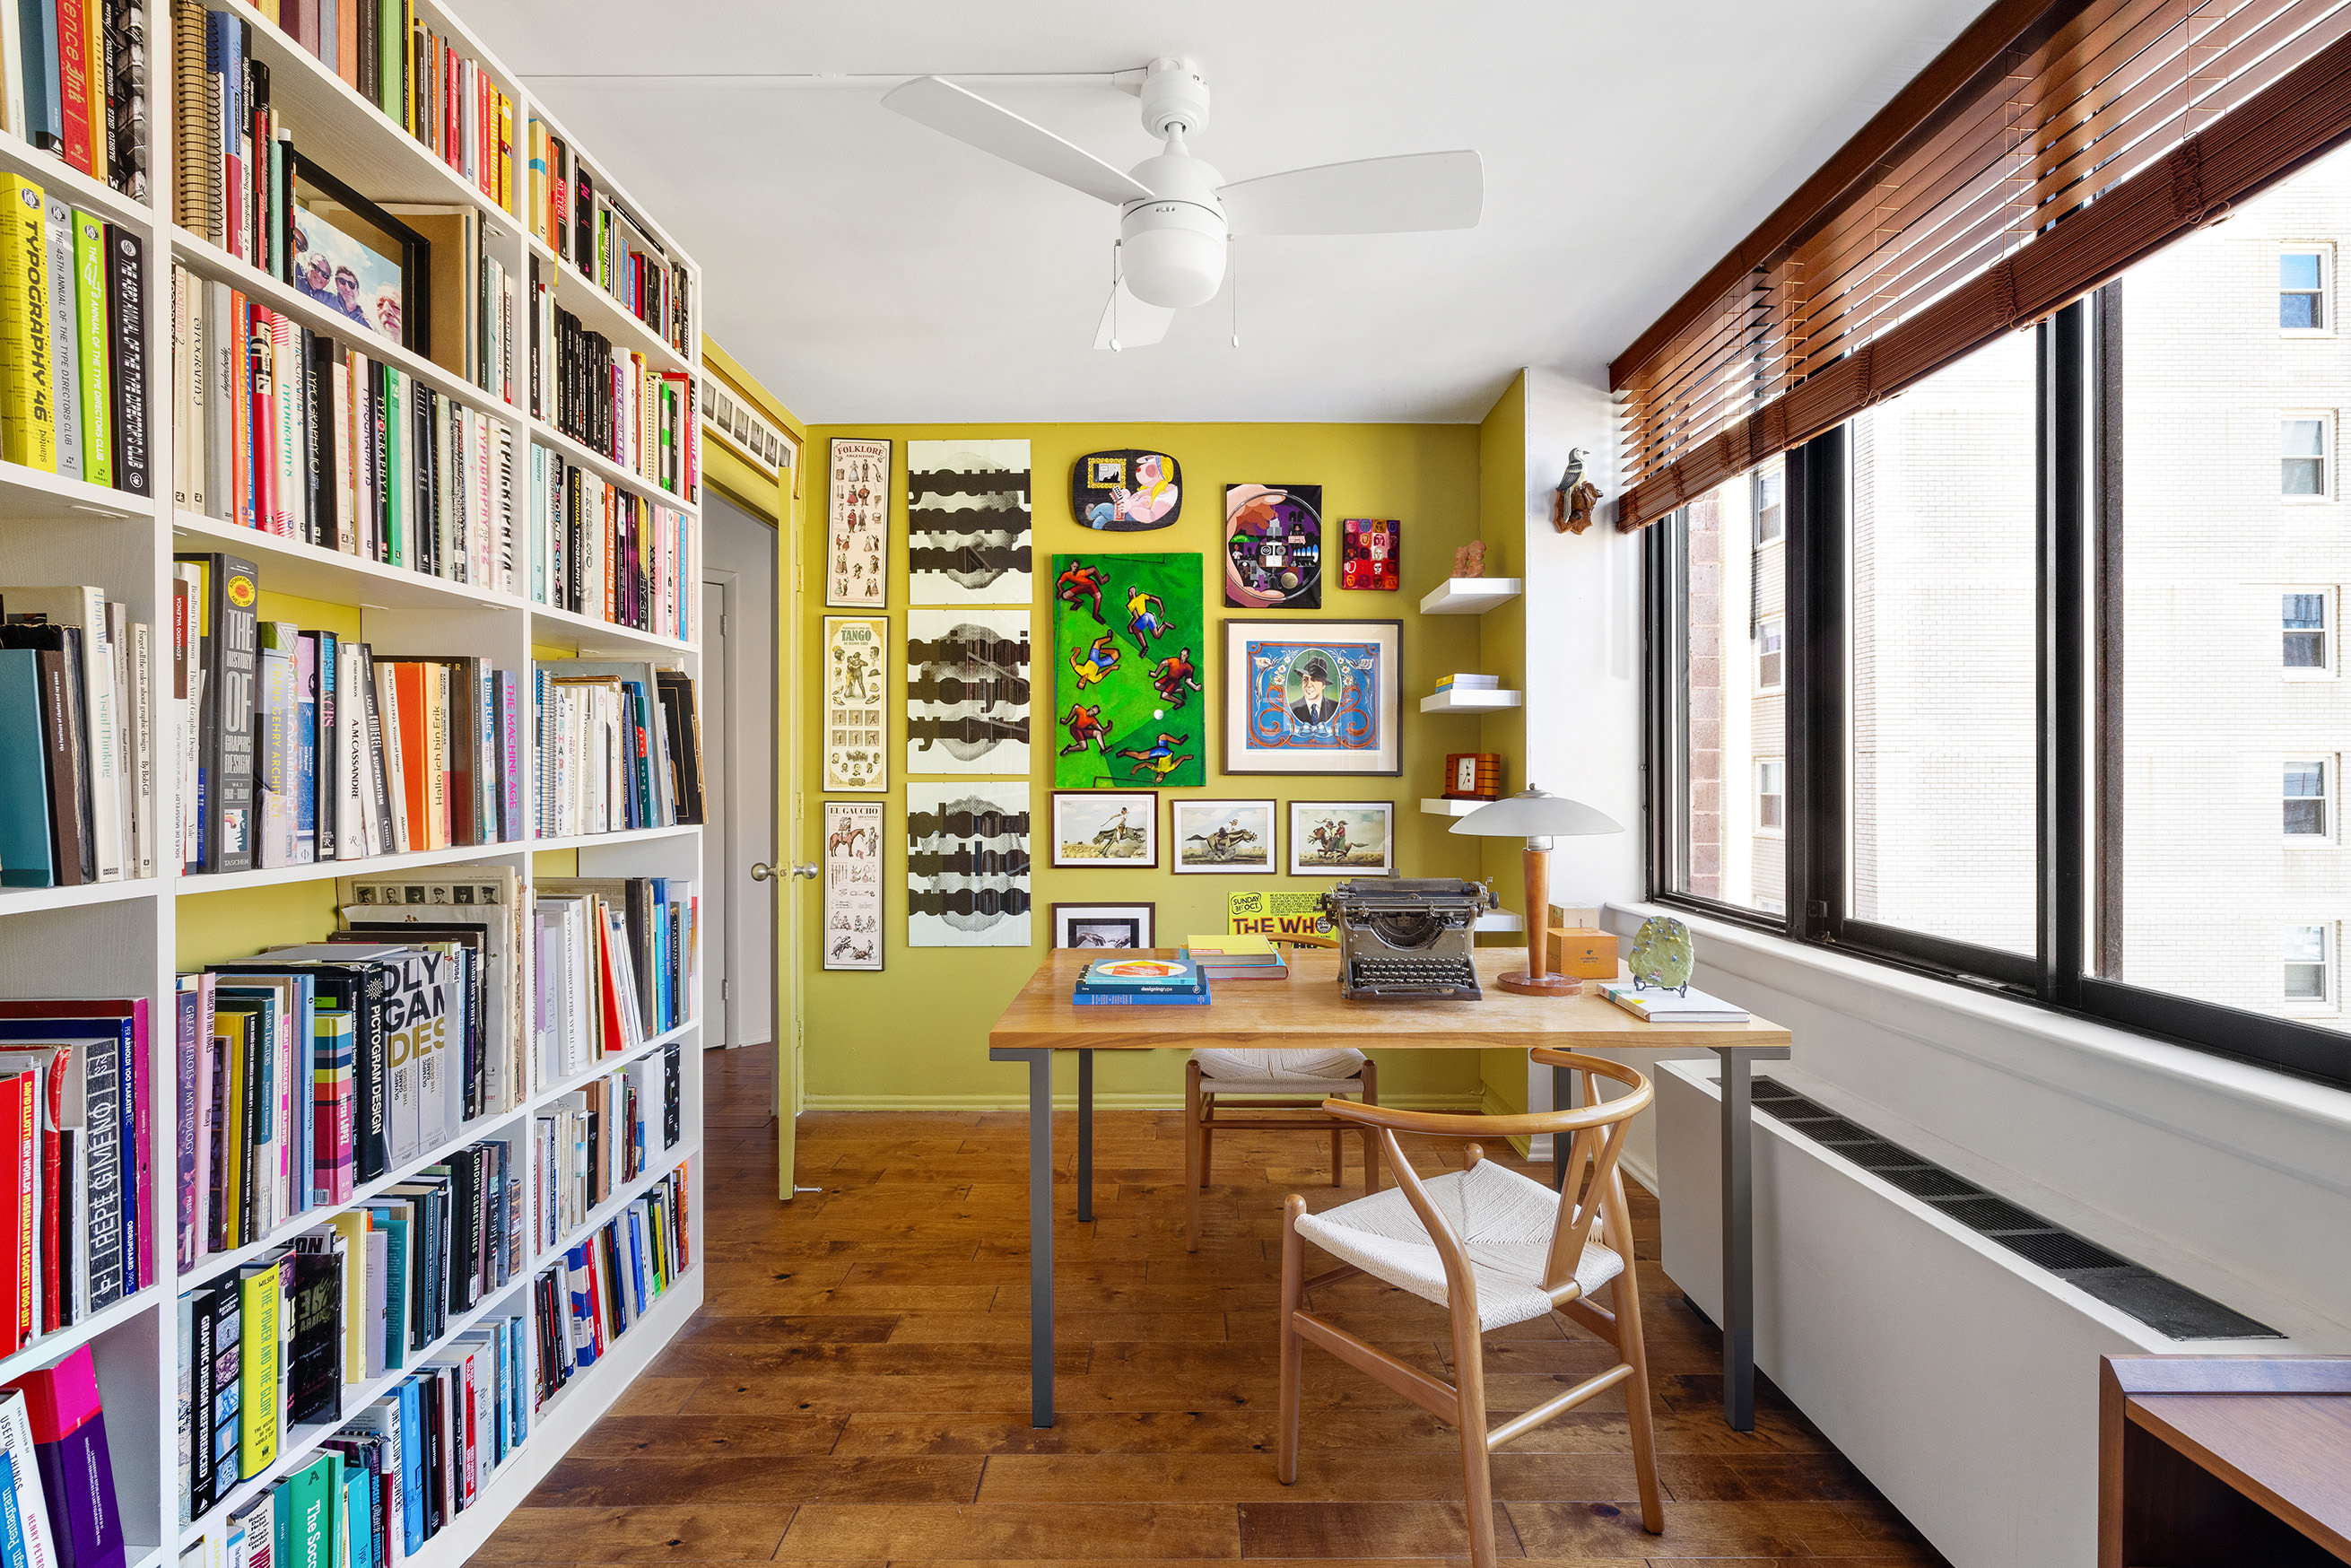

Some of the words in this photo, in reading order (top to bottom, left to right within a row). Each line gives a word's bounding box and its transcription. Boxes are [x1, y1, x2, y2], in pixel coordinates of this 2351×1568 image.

[242, 91, 250, 133] Pensamiento
[242, 163, 250, 189] Thought
[557, 179, 565, 191] MY
[242, 191, 250, 232] Typographic
[557, 191, 565, 215] TYPE
[55, 229, 64, 246] THE
[56, 248, 65, 273] 45TH
[121, 258, 137, 278] THE
[57, 273, 66, 307] ANNUAL
[122, 278, 138, 302] 43RD
[24, 221, 47, 387] TYPOGRAPHY
[58, 309, 67, 324] OF
[123, 299, 139, 335] ANNUAL
[175, 272, 187, 338] Typography
[59, 326, 68, 344] THE
[124, 336, 140, 351] OF
[176, 337, 186, 346] 2
[60, 345, 69, 367] TYPE
[125, 350, 141, 370] THE
[194, 317, 203, 397] TYPOGRAPHY
[221, 347, 231, 392] Typography
[61, 368, 71, 421] DIRECTORS
[125, 370, 141, 393] TYPE
[282, 383, 292, 466] TYPOGRAPHY
[308, 370, 319, 454] TYPOGRAPHY
[38, 428, 48, 463] slanted
[63, 422, 72, 446] CLUB
[377, 396, 387, 488] TYPOGRAPHY
[127, 444, 144, 469] CLUB
[838, 445, 884, 457] FOLKLORE
[284, 467, 293, 478] 8
[309, 457, 320, 474] 10
[478, 424, 489, 529] TYPOGRAPHY
[379, 489, 387, 504] 14
[91, 593, 105, 629] Henry
[188, 584, 198, 619] Bradbury
[137, 630, 147, 650] Forget
[188, 621, 197, 660] Thompson
[228, 610, 255, 652] THE
[841, 630, 872, 641] TANGO
[139, 650, 147, 659] all
[139, 659, 147, 669] the
[227, 650, 253, 670] HISTORY
[139, 669, 147, 686] rules
[188, 670, 196, 684] The
[188, 684, 196, 697] Art
[271, 664, 282, 702] FRANK
[188, 697, 196, 706] of
[225, 670, 252, 732] OF
[366, 694, 374, 714] LAZAR
[484, 681, 493, 704] Blue
[506, 683, 516, 710] THE
[100, 693, 111, 725] Visual
[138, 705, 148, 730] graphic
[187, 706, 196, 735] Graphic
[323, 701, 335, 727] CBS
[432, 706, 440, 727] Erik
[485, 705, 494, 735] Rider
[271, 706, 282, 747] GEHRY
[369, 714, 382, 750] KHIDEKEL
[100, 727, 113, 779] Thinking
[139, 730, 148, 754] design.
[187, 736, 196, 762] Design
[224, 735, 251, 753] GRAPHIC
[433, 731, 441, 750] bin
[507, 713, 517, 777] MACHINE
[139, 761, 148, 771] By
[224, 753, 250, 774] DESIGN
[351, 719, 359, 799] A.M.CASSANDRE
[434, 752, 442, 771] ich
[141, 771, 149, 784] Bob
[141, 784, 149, 798] Gill.
[271, 751, 282, 819] ARCHITECT
[374, 755, 384, 806] SUPREMATISM
[434, 774, 443, 806] Hallo
[508, 781, 518, 809] AGE
[224, 858, 250, 867] TASCHEN
[1232, 895, 1259, 905] SUNDAY
[1232, 917, 1275, 935] THE
[206, 989, 215, 1008] MARCH
[185, 1005, 196, 1037] GREAT
[205, 1020, 214, 1033] THE
[265, 1009, 273, 1029] FARM
[125, 1036, 133, 1066] ARNOLDI
[205, 1033, 214, 1054] FINALS
[264, 1031, 273, 1066] TRACTORS
[370, 1005, 380, 1085] PICTOGRAM
[185, 1040, 195, 1079] HEROES
[23, 1081, 32, 1104] DAVID
[185, 1081, 194, 1089] of
[185, 1091, 195, 1155] MYTHOLOGY
[371, 1086, 381, 1135] DESIGN
[281, 1110, 289, 1146] MAJEWSKI
[22, 1139, 32, 1157] NEW
[89, 1102, 115, 1190] GIMENO
[22, 1157, 32, 1194] WORLDS
[22, 1194, 31, 1226] RUSSIAN
[472, 1194, 480, 1254] CEMETERIES
[126, 1220, 135, 1270] ORDRUPGAARD
[127, 1271, 135, 1286] 1995
[258, 1275, 274, 1288] WILSON
[20, 1286, 30, 1328] 1900-1937
[261, 1285, 273, 1307] THE
[200, 1314, 210, 1364] GRAPHIC
[261, 1308, 273, 1343] POWER
[261, 1344, 273, 1365] AND
[200, 1365, 209, 1406] DESIGN
[260, 1367, 272, 1386] THE
[259, 1388, 272, 1419] GLORY
[391, 1409, 400, 1427] ONE
[0, 1415, 15, 1450] USEFUL
[10, 1454, 23, 1491] THINGS
[198, 1407, 209, 1478] REFERENCED
[392, 1428, 402, 1463] MILLION
[371, 1475, 379, 1504] PROCESS
[395, 1463, 404, 1512] FOLLOWERS
[2, 1487, 22, 1550] Pentagram
[28, 1513, 39, 1542] HENRY
[307, 1499, 321, 1530] The
[372, 1504, 380, 1533] COLOUR
[373, 1533, 381, 1561] FINDER
